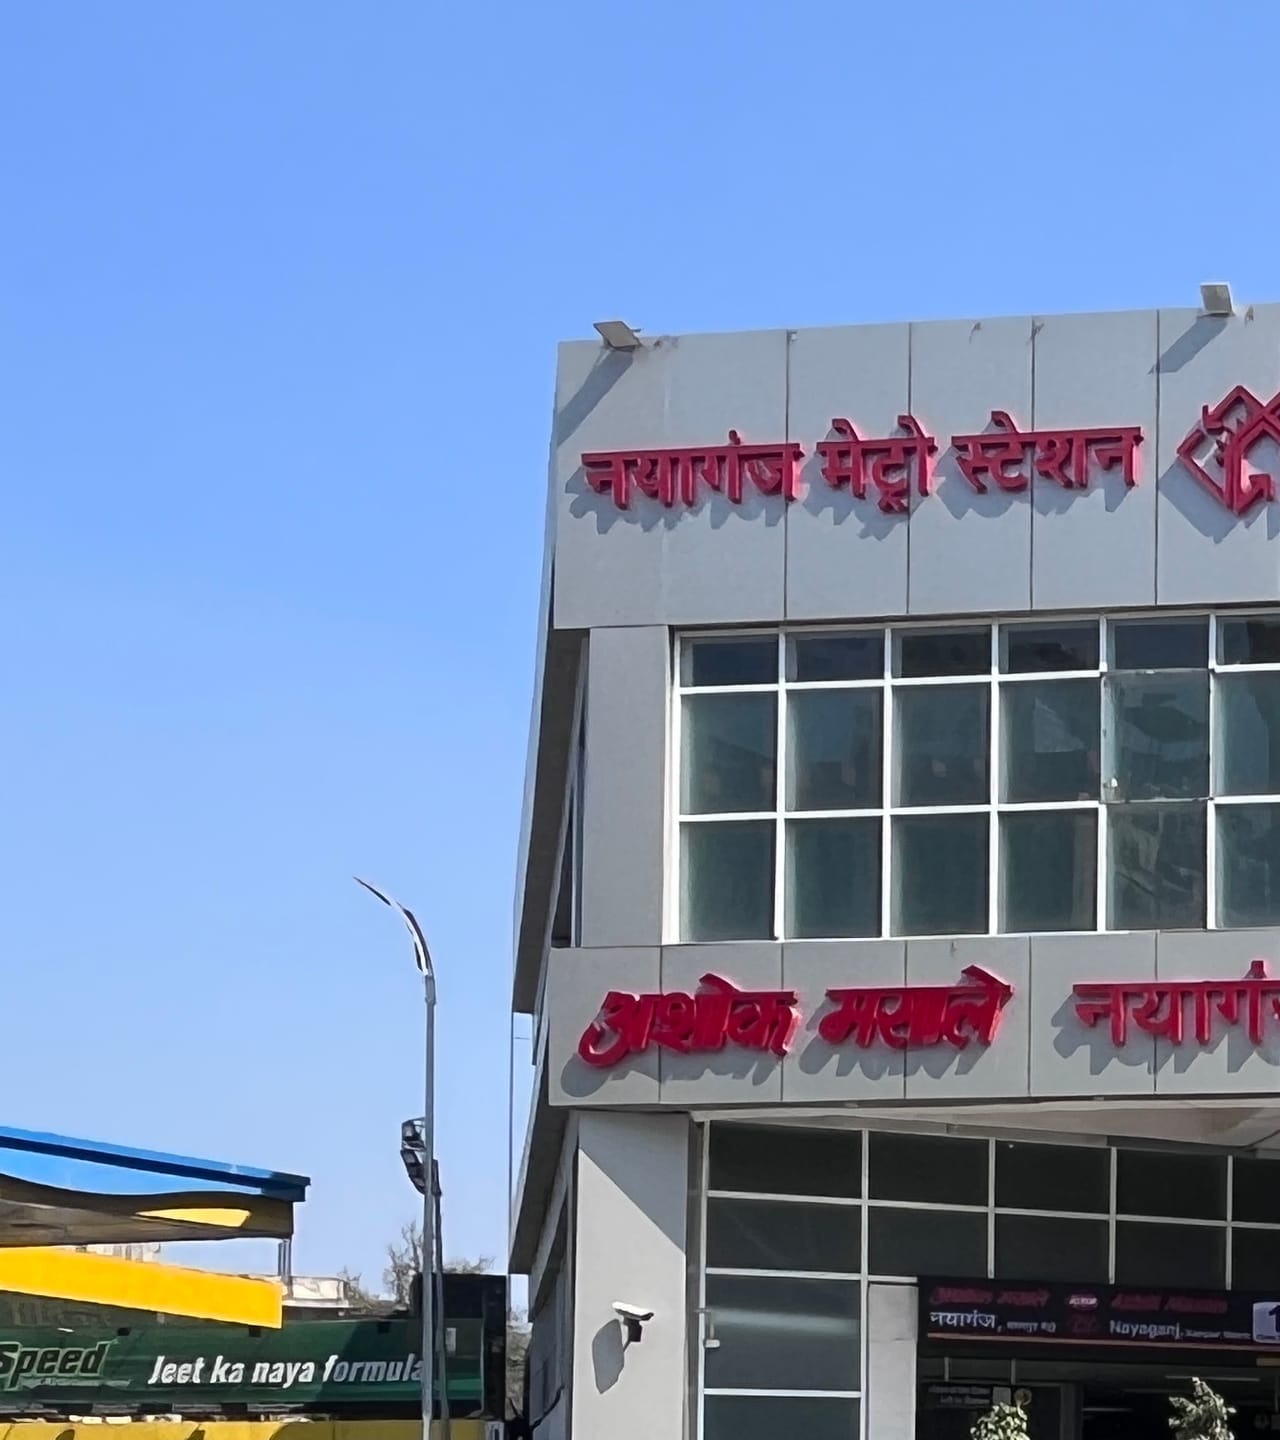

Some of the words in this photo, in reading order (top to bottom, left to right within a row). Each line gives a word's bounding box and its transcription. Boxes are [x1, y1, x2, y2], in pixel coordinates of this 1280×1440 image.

[581, 429, 805, 512] नयागंज
[815, 413, 938, 515] मेट्रो
[950, 410, 1144, 495] स्टेशन
[209, 1355, 246, 1384] ka
[251, 1360, 316, 1389] naya
[322, 1353, 424, 1383] formula
